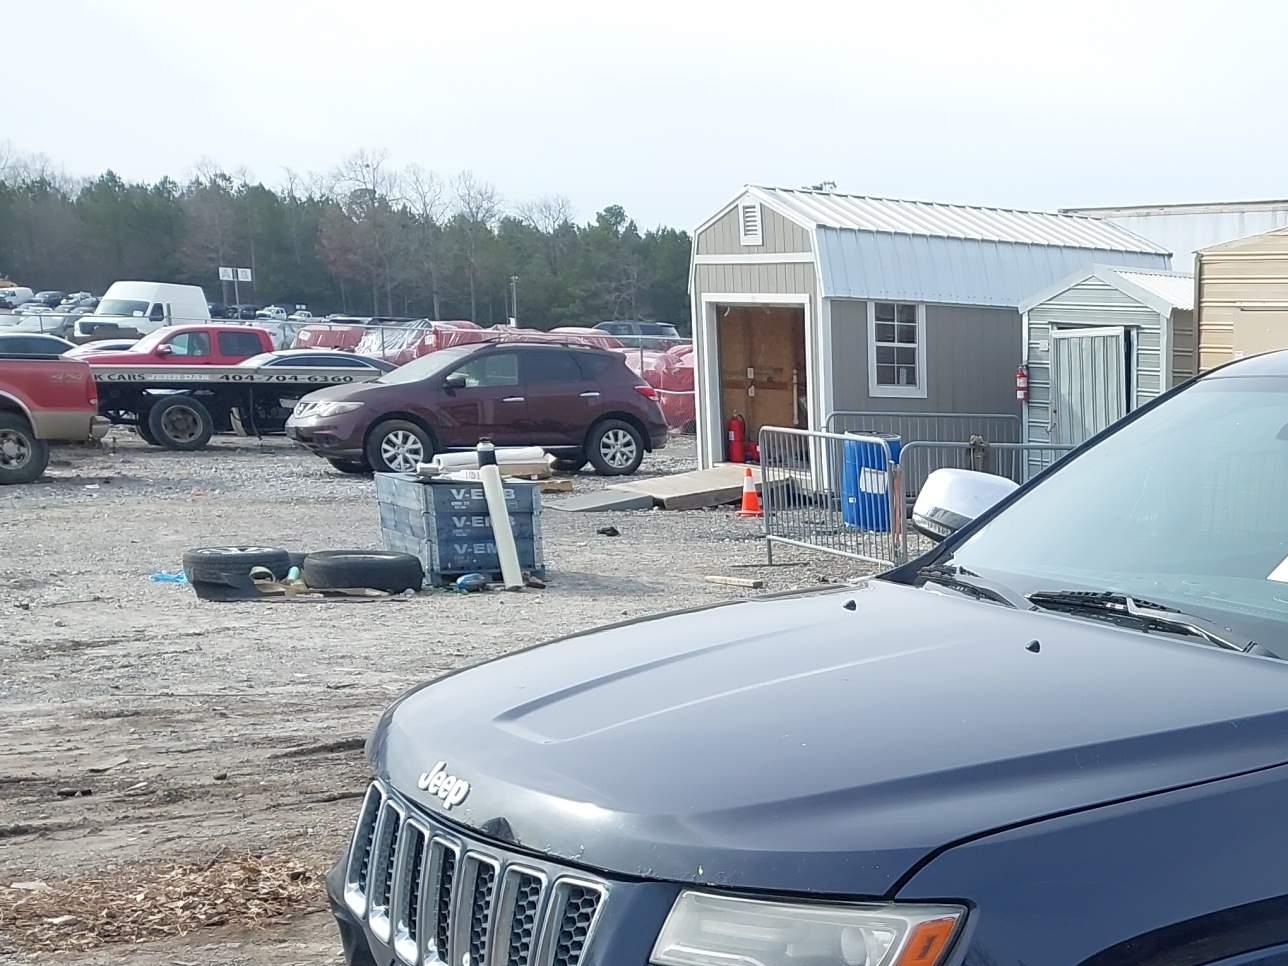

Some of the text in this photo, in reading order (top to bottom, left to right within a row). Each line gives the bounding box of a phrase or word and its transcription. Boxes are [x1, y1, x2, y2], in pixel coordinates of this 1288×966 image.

[107, 373, 146, 381] CARS
[220, 374, 354, 383] 404-704-6360
[450, 488, 516, 500] V-EB
[418, 760, 470, 811] Jeep
